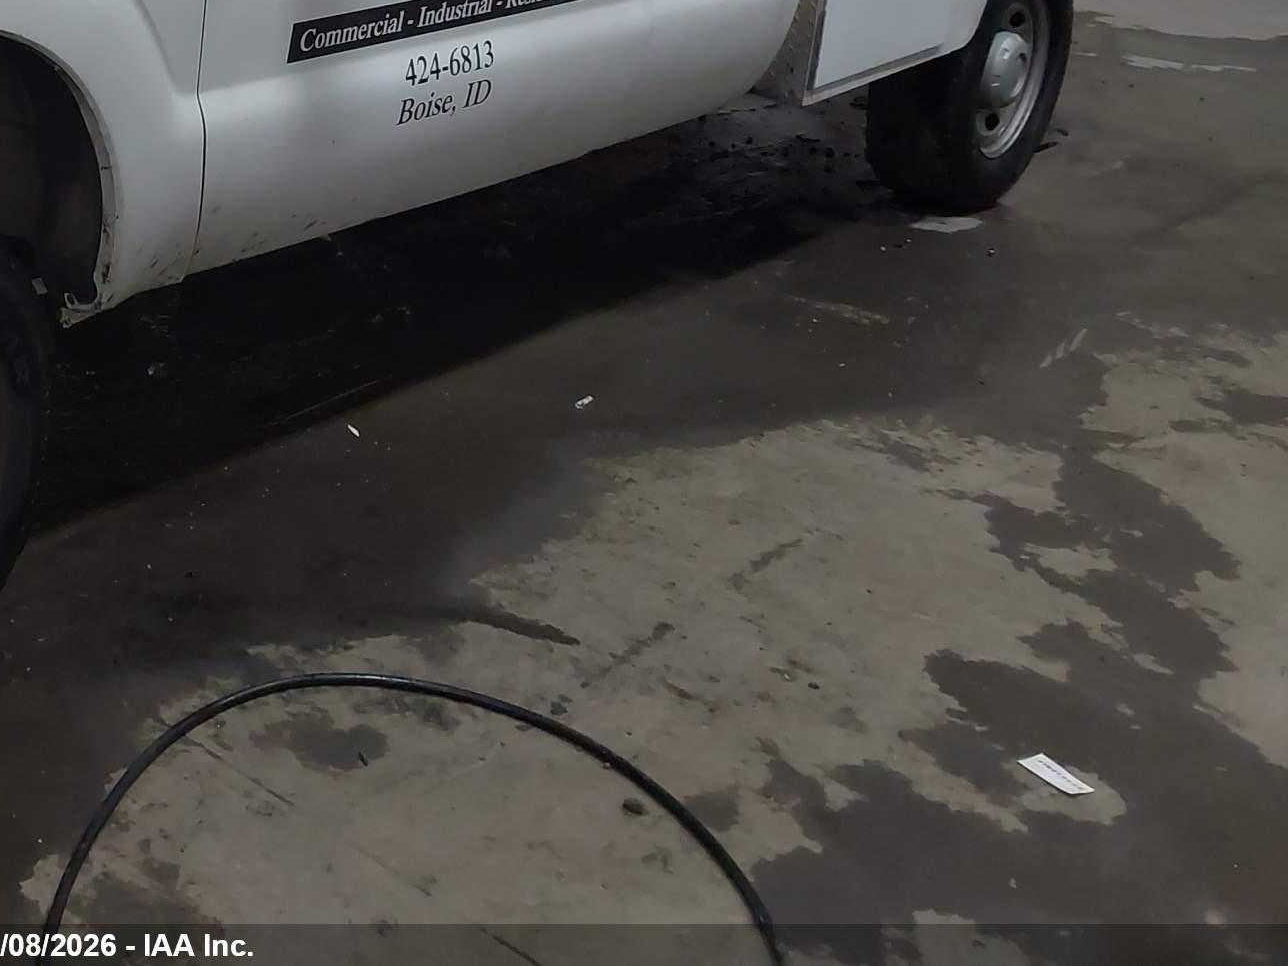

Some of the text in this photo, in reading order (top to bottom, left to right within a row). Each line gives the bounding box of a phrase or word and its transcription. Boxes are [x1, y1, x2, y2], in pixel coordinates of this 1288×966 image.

[300, 10, 404, 52] Commercial
[405, 40, 494, 86] 424-6813
[396, 79, 492, 125] Boise, ID
